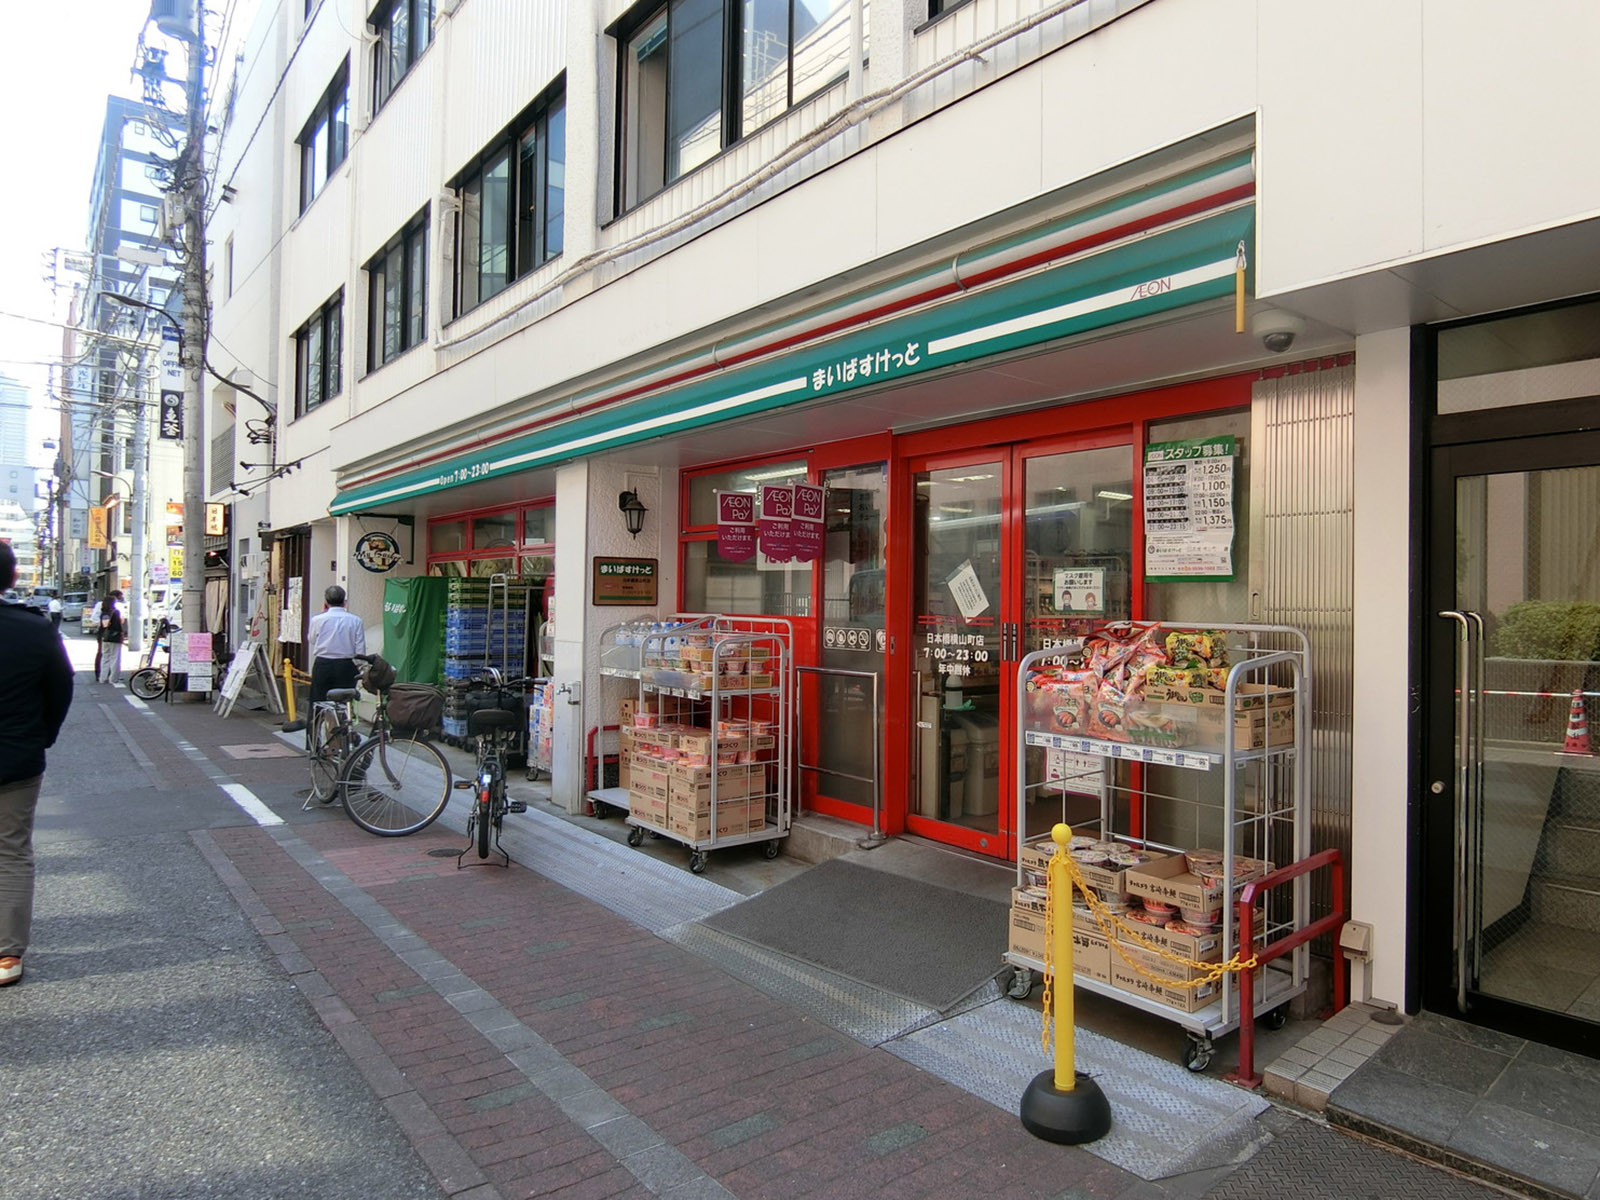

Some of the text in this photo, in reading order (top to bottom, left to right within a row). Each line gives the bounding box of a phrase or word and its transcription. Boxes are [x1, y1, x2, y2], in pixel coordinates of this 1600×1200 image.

[812, 342, 921, 391] まいばすけっと
[600, 564, 653, 575] まいばすけっと
[926, 632, 985, 647] 日本橋横山町店
